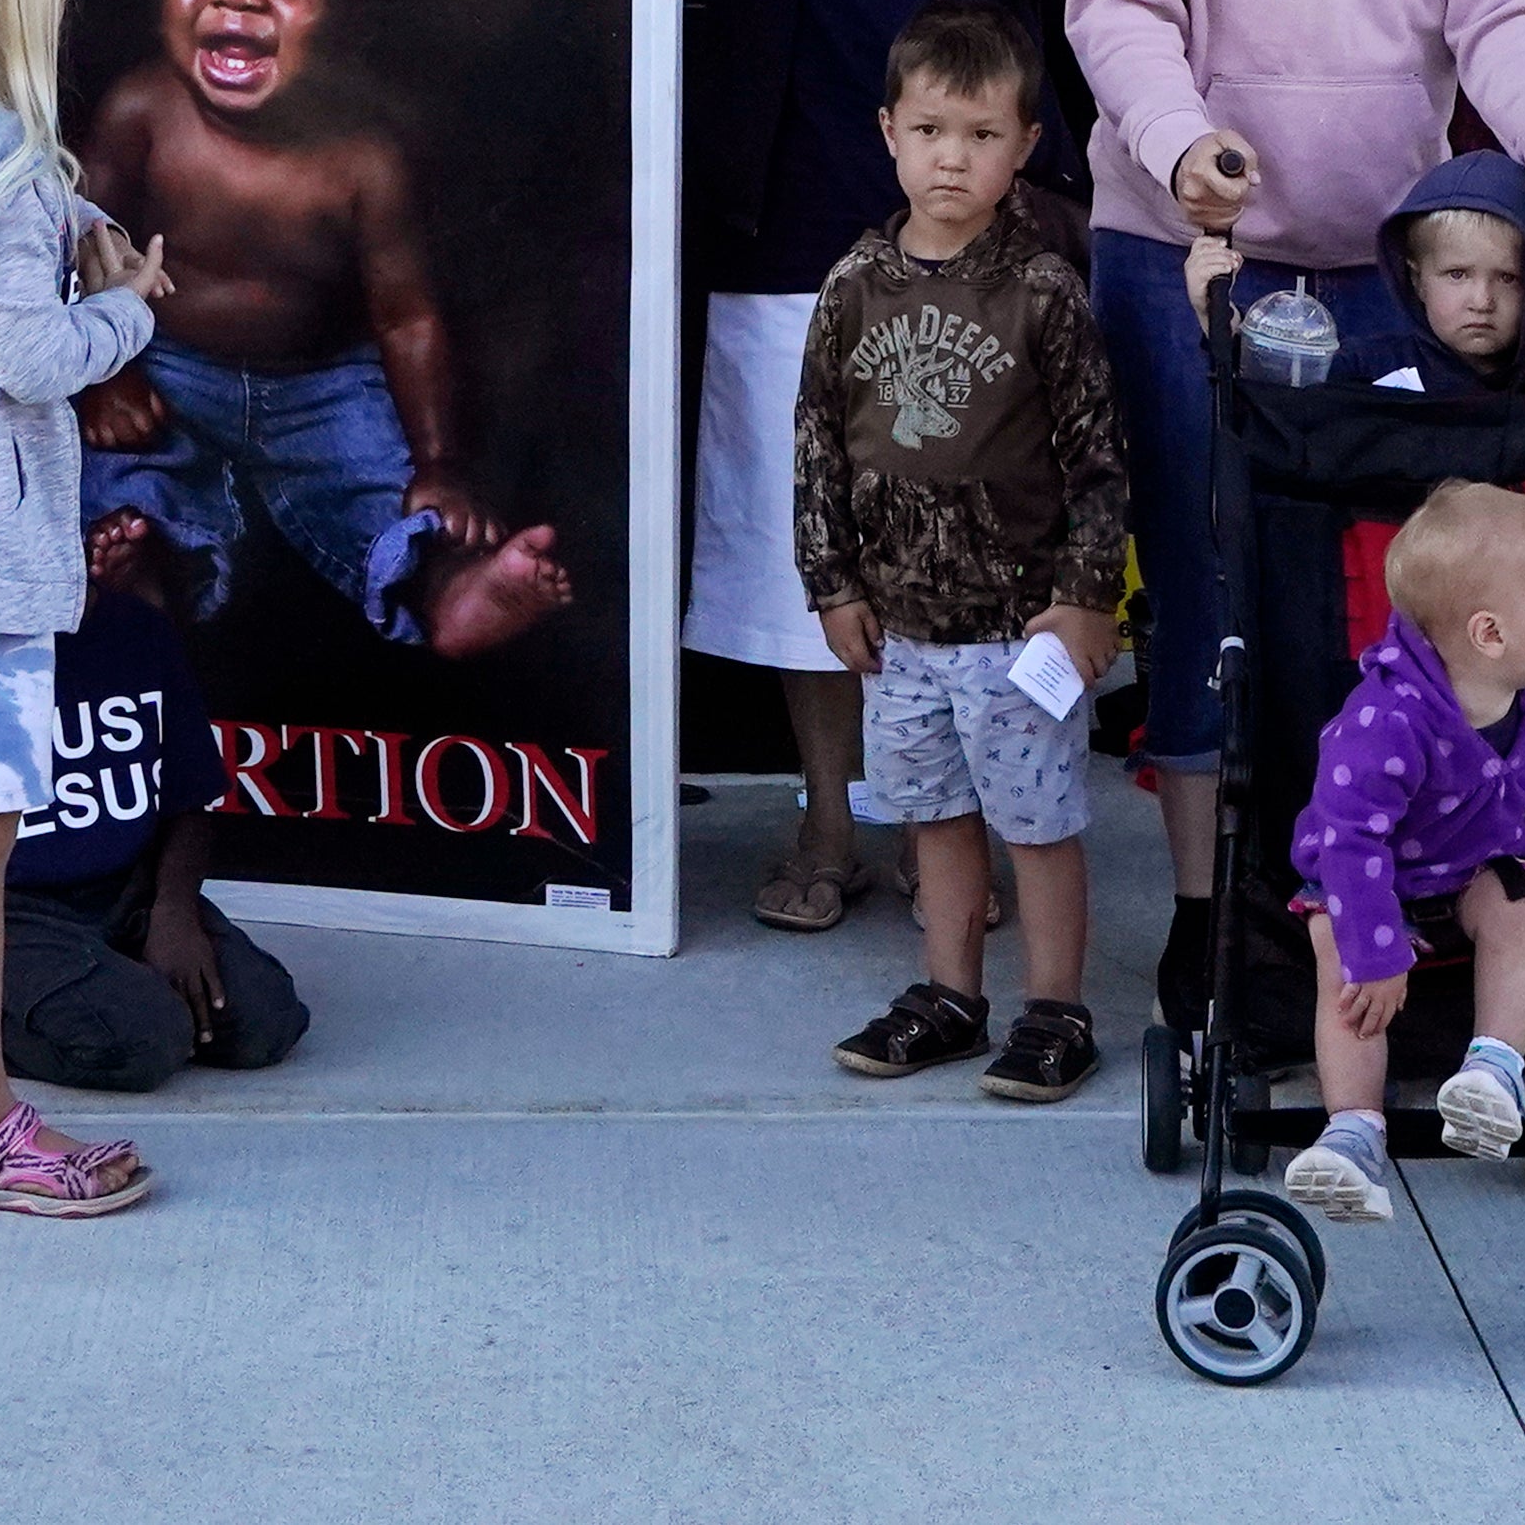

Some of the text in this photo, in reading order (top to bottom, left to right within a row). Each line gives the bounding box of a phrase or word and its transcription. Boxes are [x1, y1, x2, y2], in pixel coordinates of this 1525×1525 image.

[849, 303, 1018, 384] JOHN DEERE
[877, 384, 972, 404] 18 37
[16, 757, 163, 840] ESU
